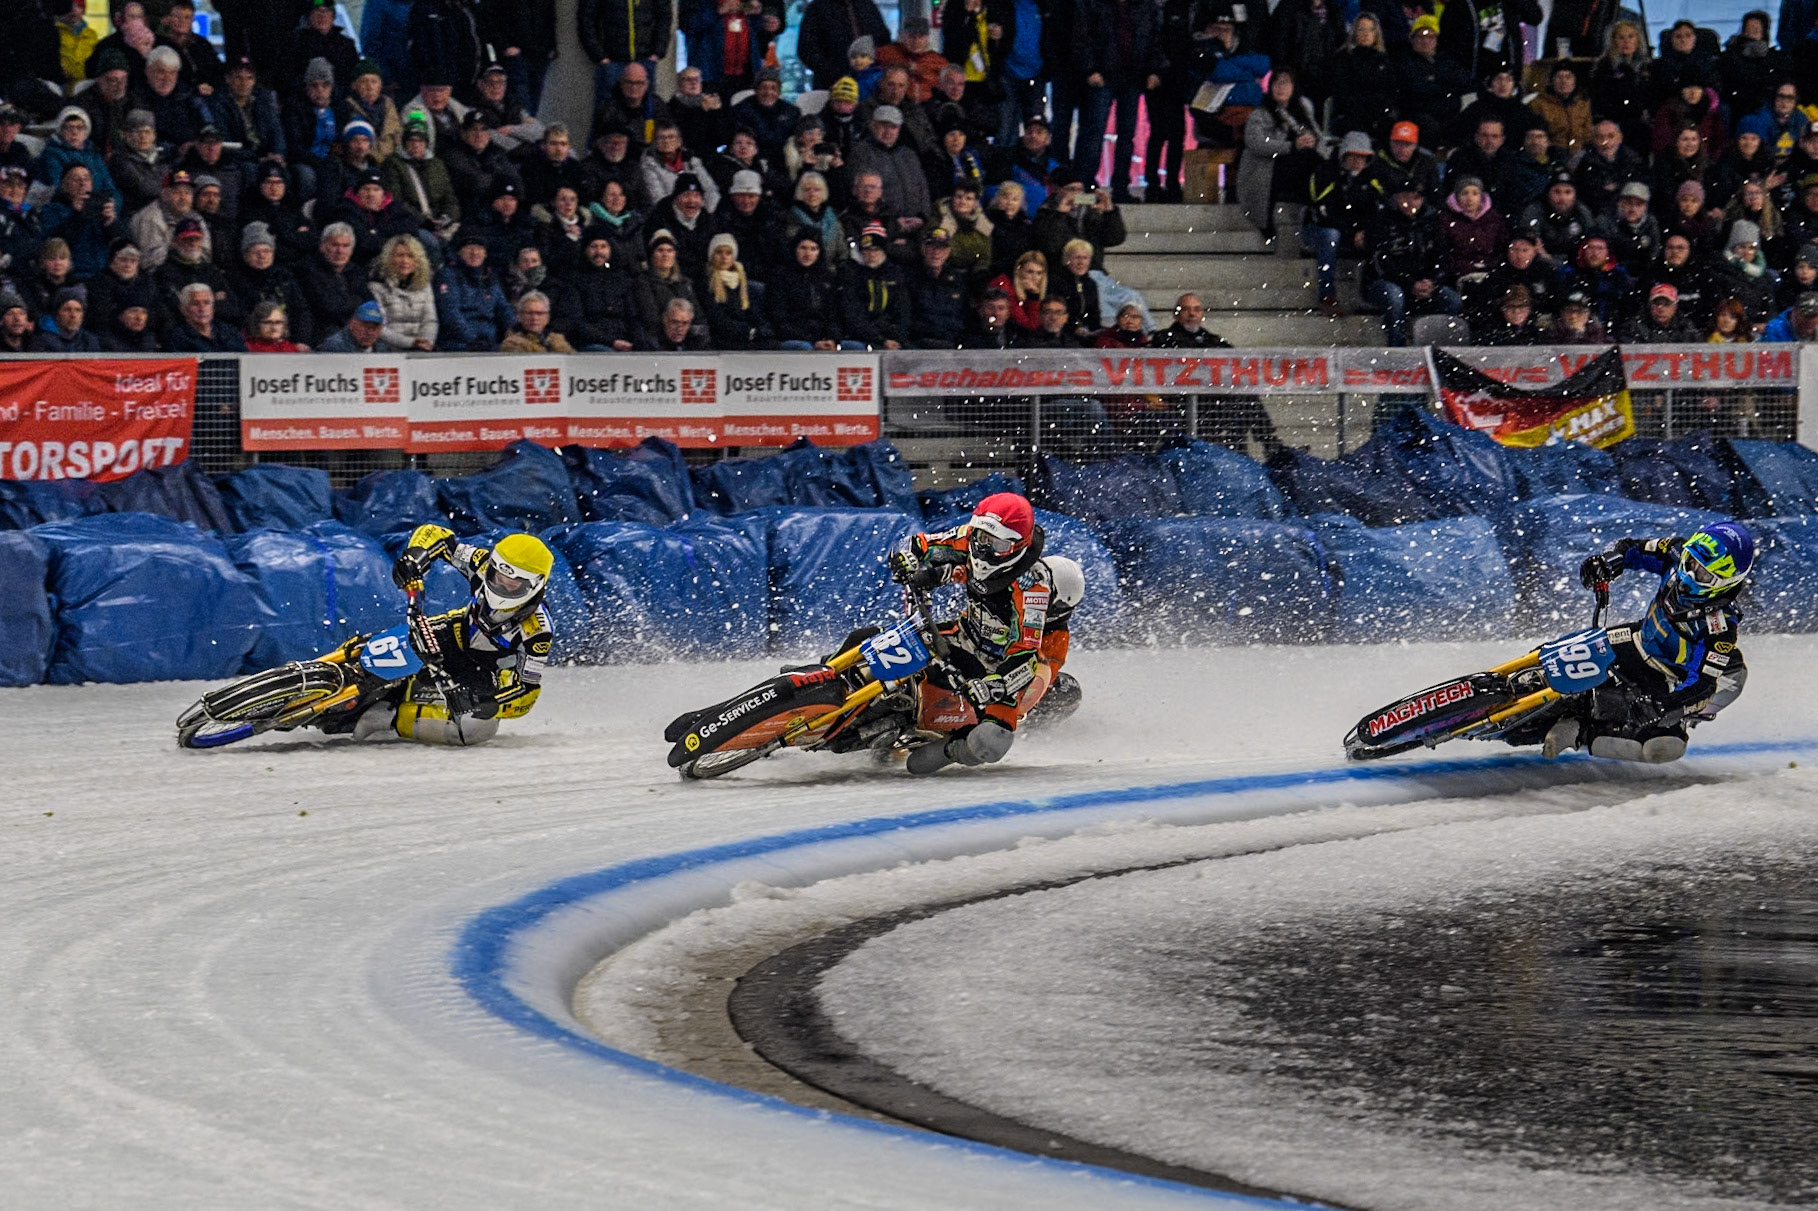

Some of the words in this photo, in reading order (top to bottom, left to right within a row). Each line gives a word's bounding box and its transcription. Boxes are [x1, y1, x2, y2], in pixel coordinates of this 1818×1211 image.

[115, 374, 160, 393] Ideal
[166, 372, 190, 391] für
[725, 372, 775, 395] Josef
[779, 372, 832, 391] Fuchs
[1101, 357, 1328, 386] VITZTHUM
[249, 374, 299, 398] Josef
[305, 373, 358, 392] Fuchs
[410, 376, 462, 401] Josef
[467, 375, 519, 395] Fuchs
[568, 374, 618, 397] Josef
[623, 373, 676, 393] Fuchs
[35, 401, 105, 421] Familie
[367, 635, 408, 668] 67
[871, 629, 913, 670] 82
[1558, 643, 1601, 680] 99
[1368, 680, 1475, 737] MACHTECH
